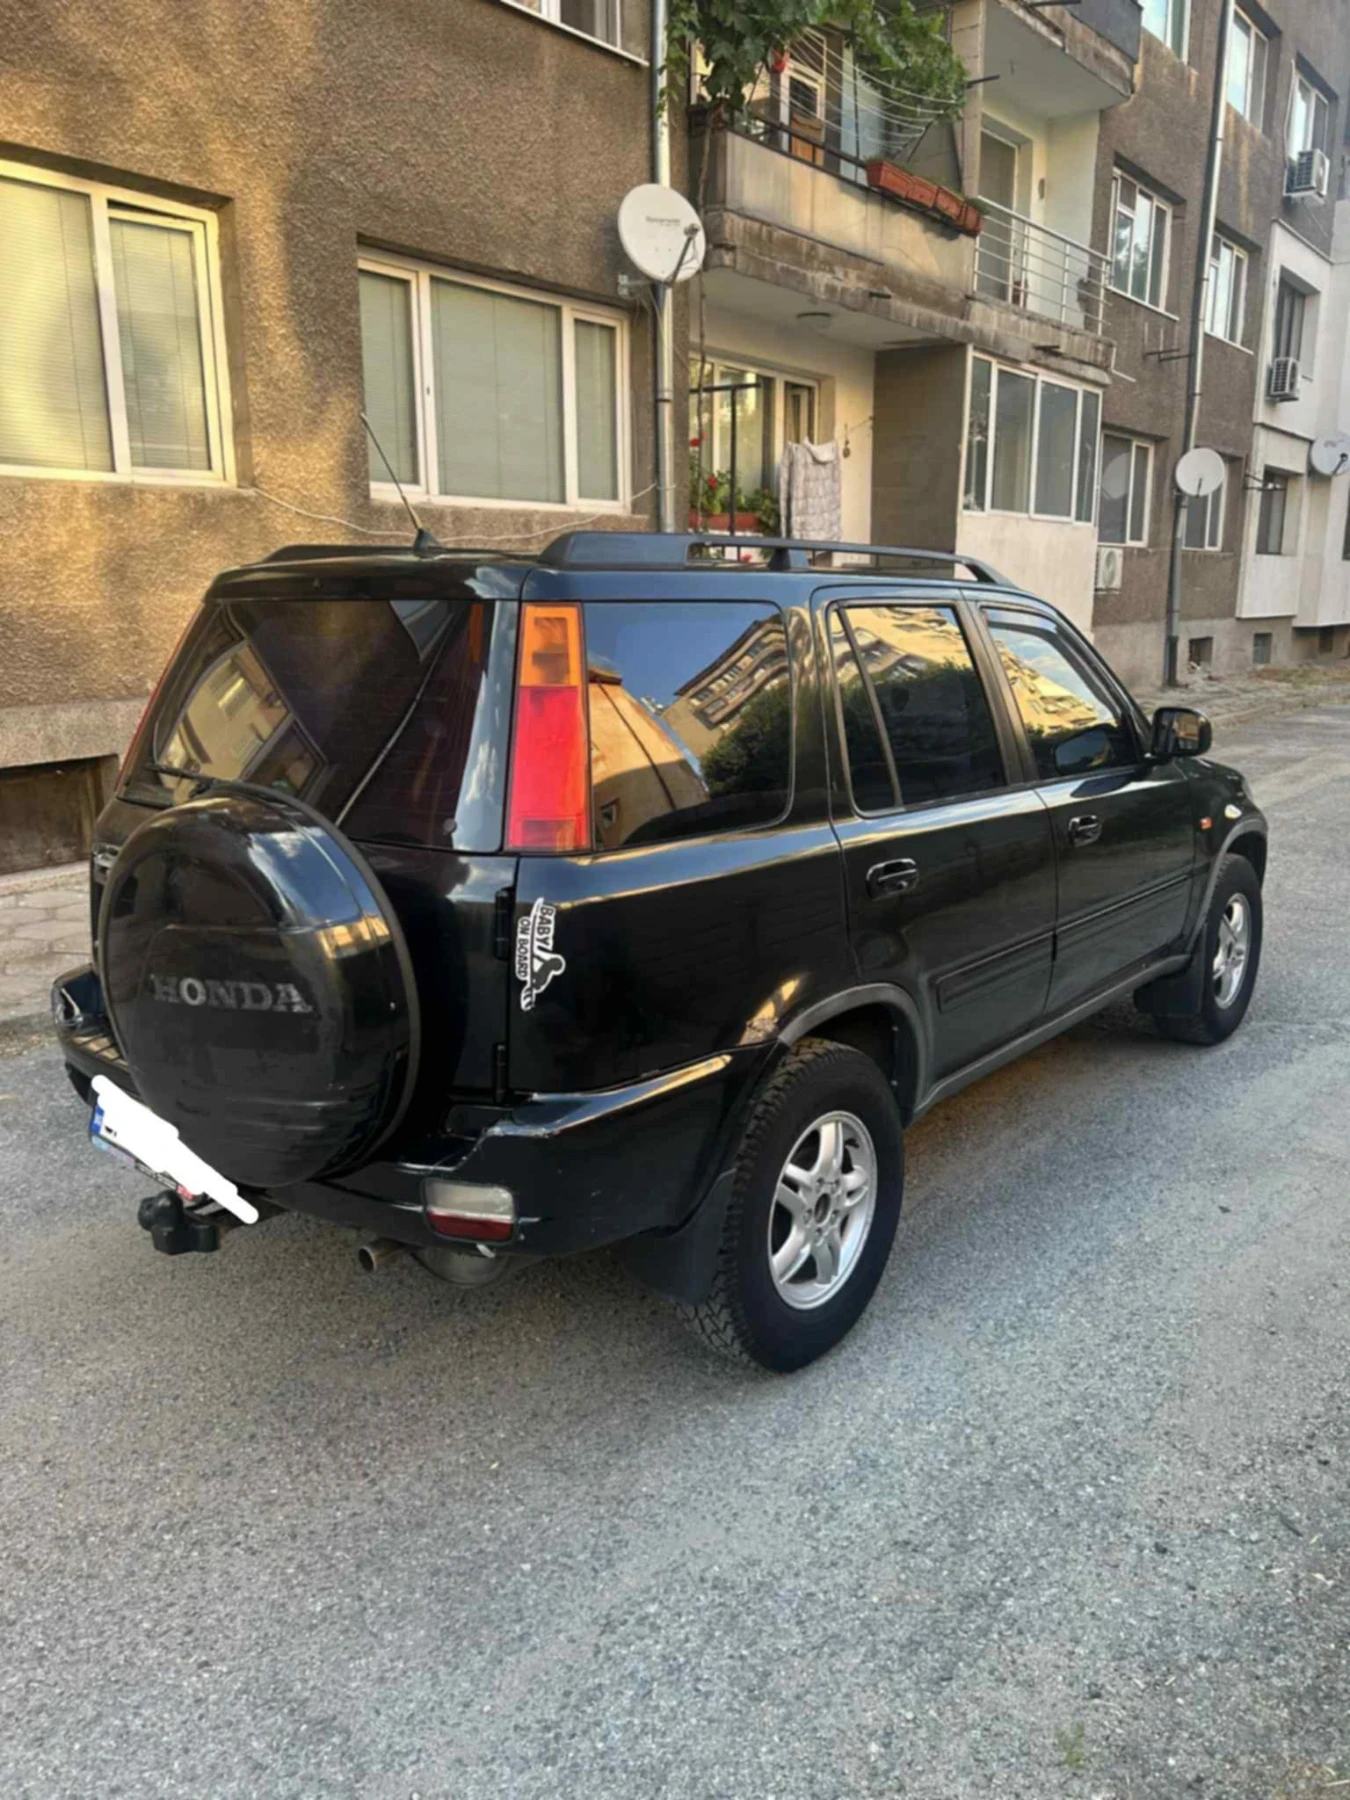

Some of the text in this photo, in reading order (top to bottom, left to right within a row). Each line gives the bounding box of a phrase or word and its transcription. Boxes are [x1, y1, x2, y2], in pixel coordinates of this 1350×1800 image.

[536, 906, 554, 946] BABY
[518, 918, 531, 978] ON BOARD
[150, 974, 313, 1013] HONDA
